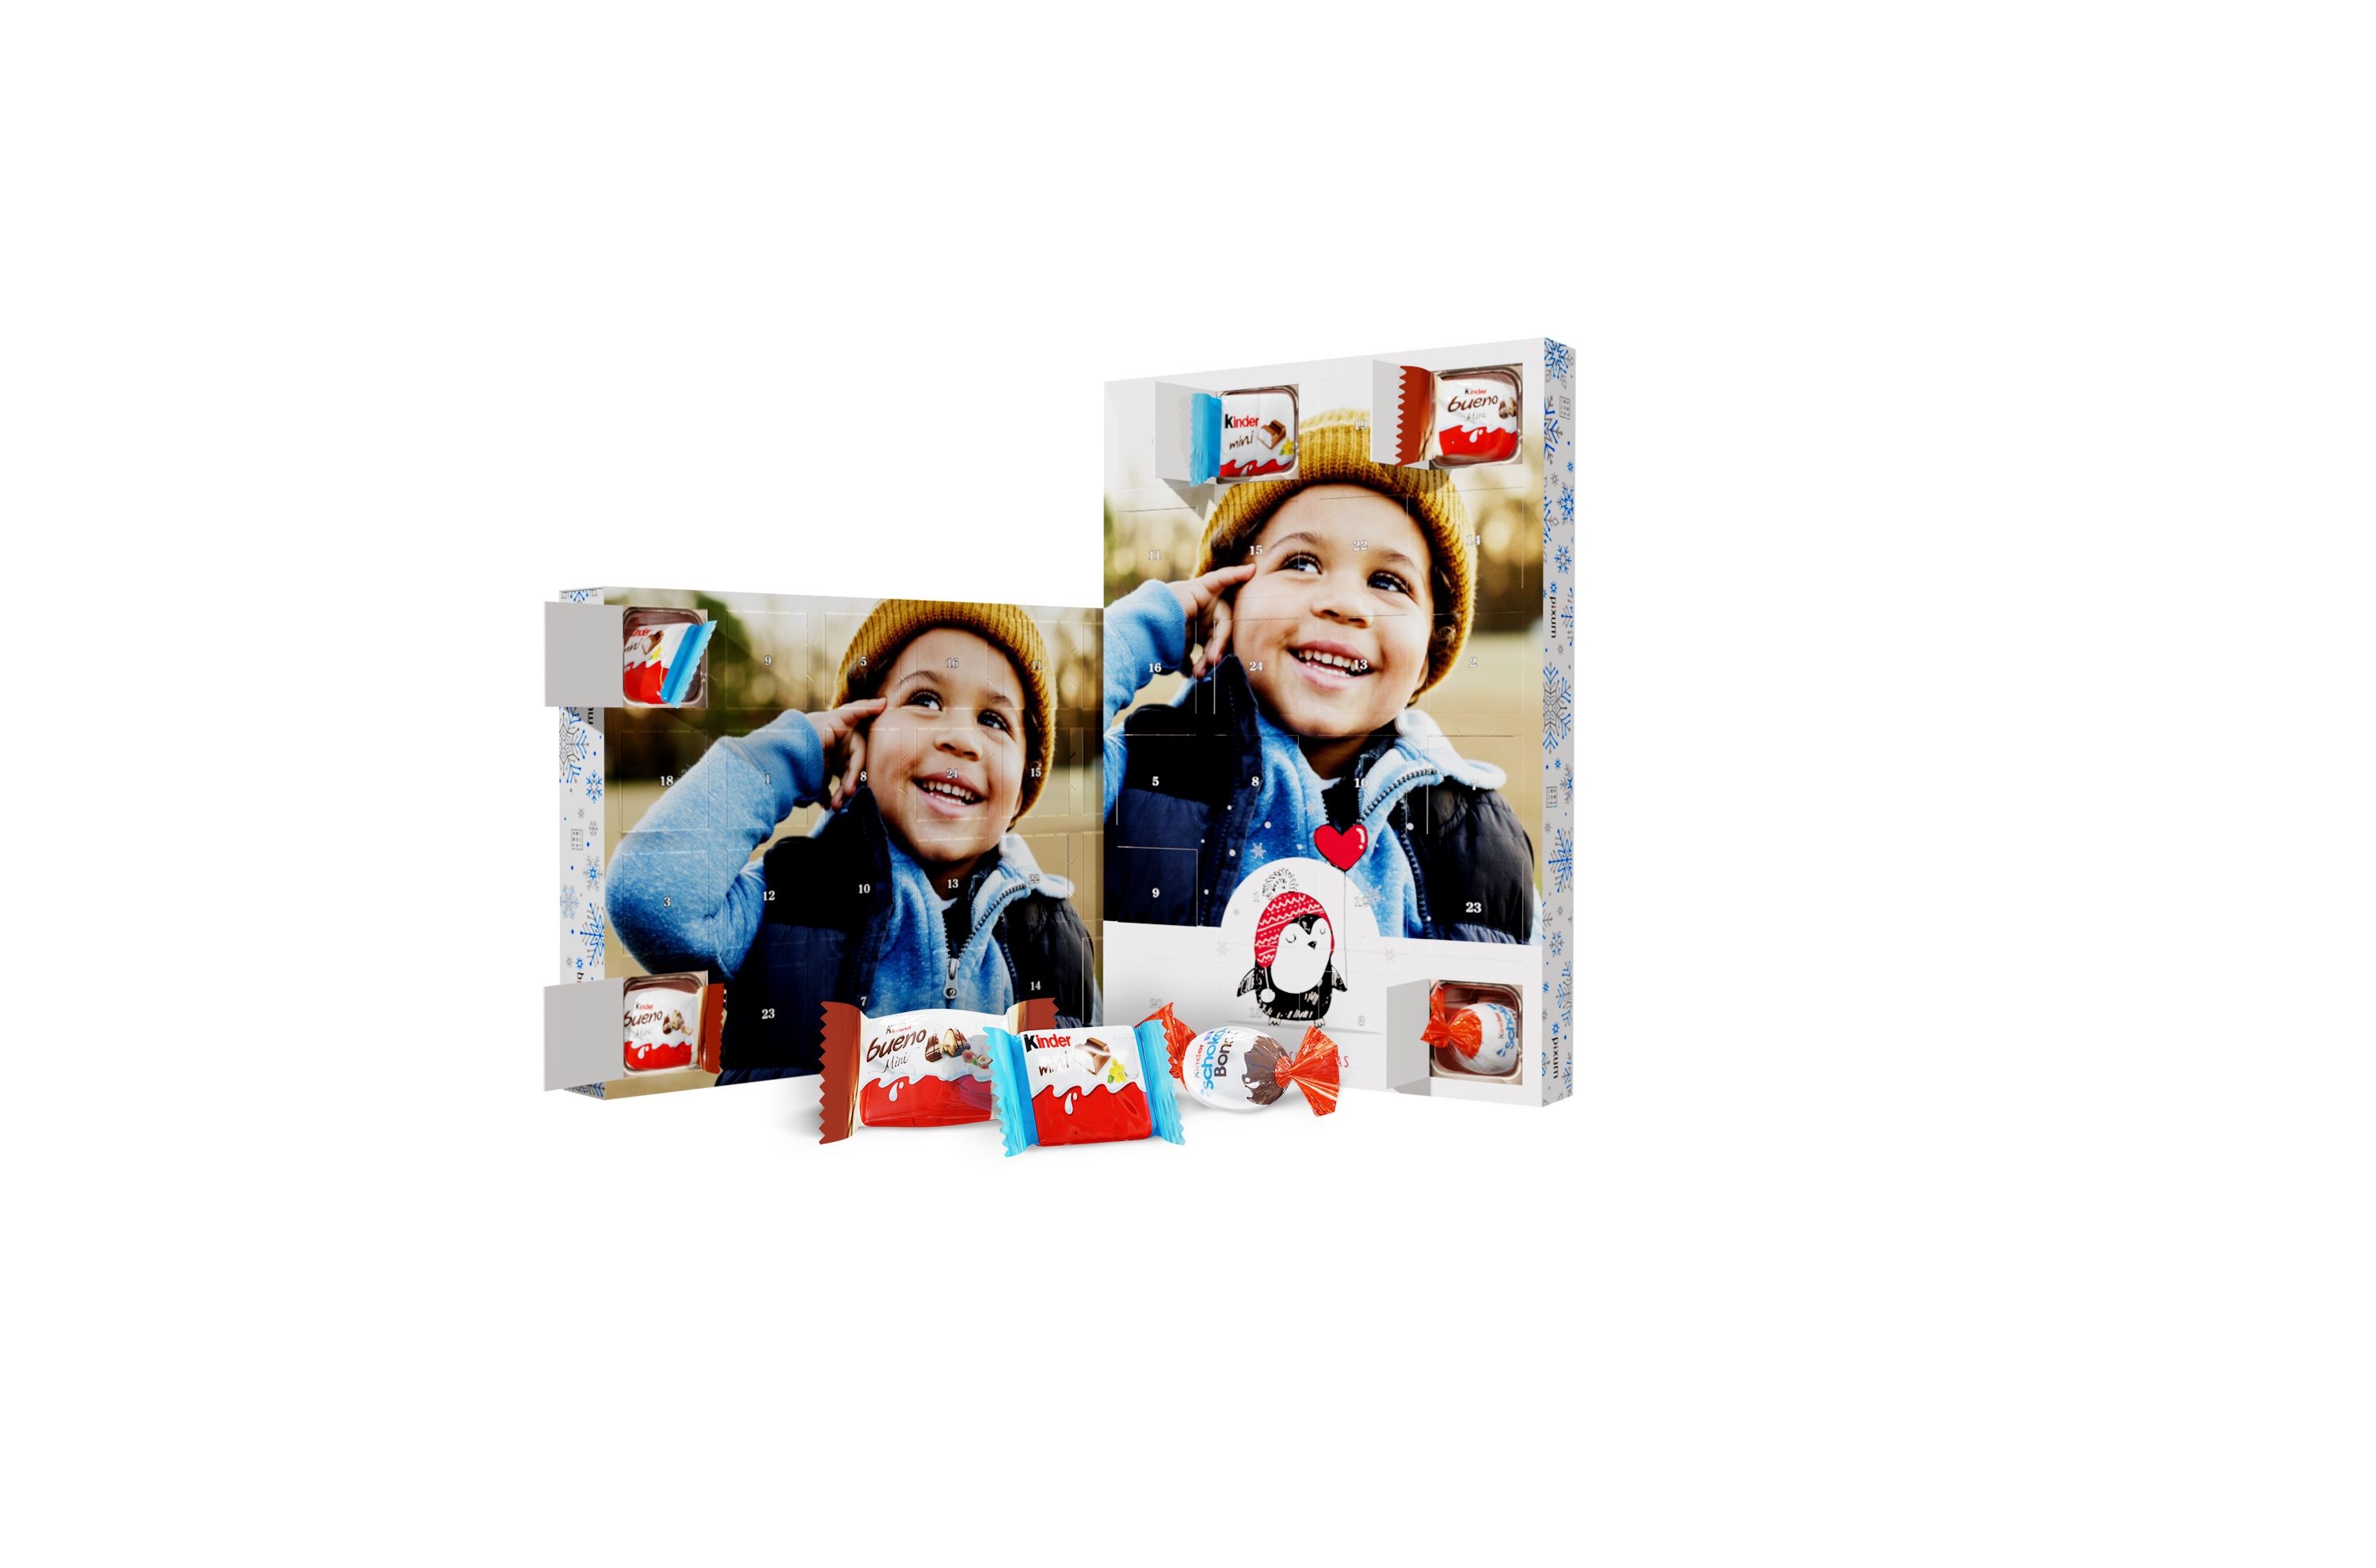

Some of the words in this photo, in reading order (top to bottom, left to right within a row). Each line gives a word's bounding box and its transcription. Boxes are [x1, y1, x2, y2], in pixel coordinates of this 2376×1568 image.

[1448, 395, 1498, 413] bueno
[1224, 413, 1259, 428] Kinder
[1353, 420, 1369, 431] 19
[1229, 429, 1254, 450] mini
[1353, 540, 1369, 551] 22
[1466, 535, 1482, 546] 14
[1148, 550, 1161, 561] 11
[1249, 545, 1263, 556] 15
[764, 655, 772, 667] 9
[860, 656, 867, 667] 5
[946, 658, 959, 669] 16
[1031, 660, 1042, 671] 11
[1249, 661, 1263, 672] 24
[1354, 659, 1368, 670] 13
[1468, 657, 1477, 668] 2
[1148, 662, 1162, 672] 16
[860, 771, 867, 782] 8
[946, 768, 959, 779] 24
[1030, 767, 1041, 778] 15
[660, 775, 674, 787] 18
[765, 774, 771, 785] 1
[1152, 776, 1159, 786] 5
[1251, 776, 1259, 786] 8
[1354, 778, 1369, 788] 10
[1471, 780, 1479, 790] 7
[947, 878, 959, 889] 13
[1028, 873, 1041, 884] 22
[858, 884, 870, 894] 10
[1152, 888, 1160, 898] 9
[763, 890, 775, 901] 12
[664, 896, 671, 908] 3
[1465, 902, 1482, 913] 23
[1030, 980, 1041, 991] 14
[950, 988, 956, 998] 2
[860, 996, 866, 1007] 7
[624, 1010, 663, 1027] bueno
[761, 1008, 775, 1019] 23
[866, 1029, 927, 1063] bueno
[1023, 1033, 1071, 1052] Kinder
